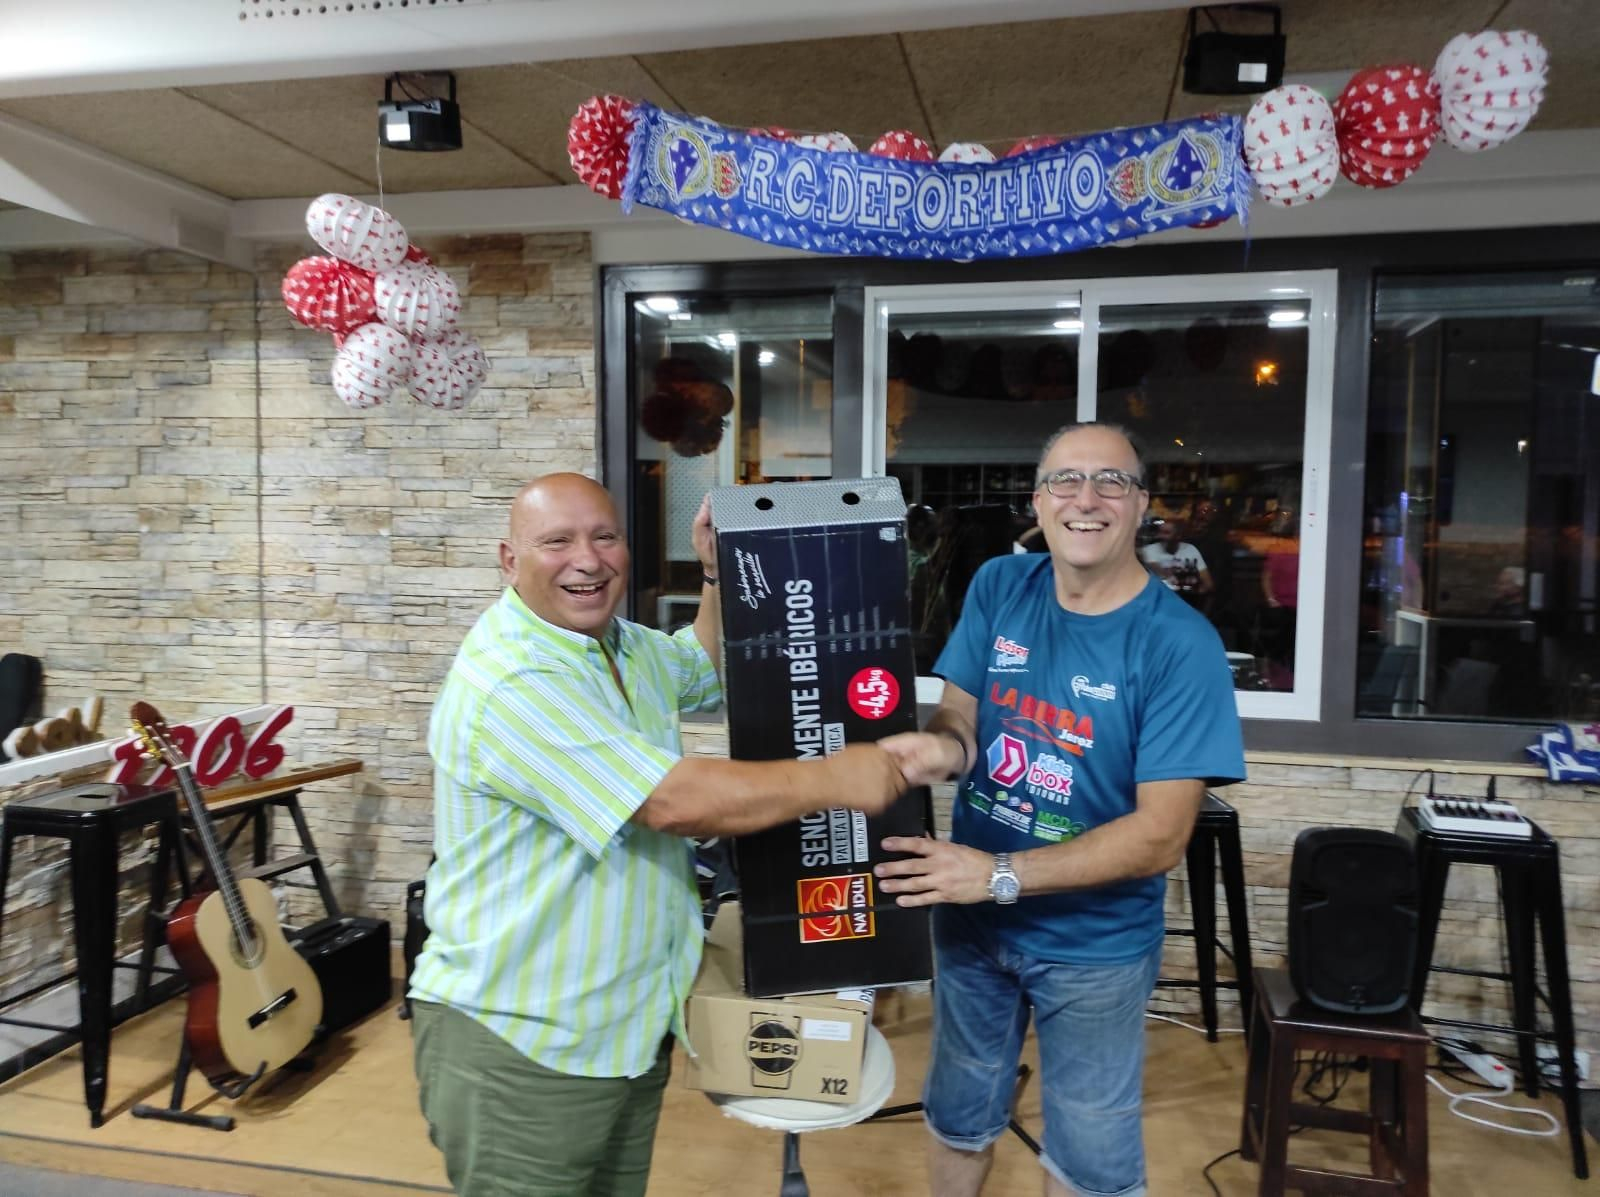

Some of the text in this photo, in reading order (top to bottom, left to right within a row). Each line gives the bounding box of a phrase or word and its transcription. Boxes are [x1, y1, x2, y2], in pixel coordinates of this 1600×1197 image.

[745, 146, 1105, 232] R.C.DEPORTIVO
[990, 682, 1017, 710] LA
[783, 578, 830, 868] SENCMENTE IBÉRICOS
[1058, 728, 1094, 748] Jerez
[1029, 763, 1072, 795] box
[1038, 753, 1073, 777] Kids
[834, 822, 849, 861] PALETA
[748, 1040, 798, 1056] PEPSI
[821, 1077, 849, 1096] X12
